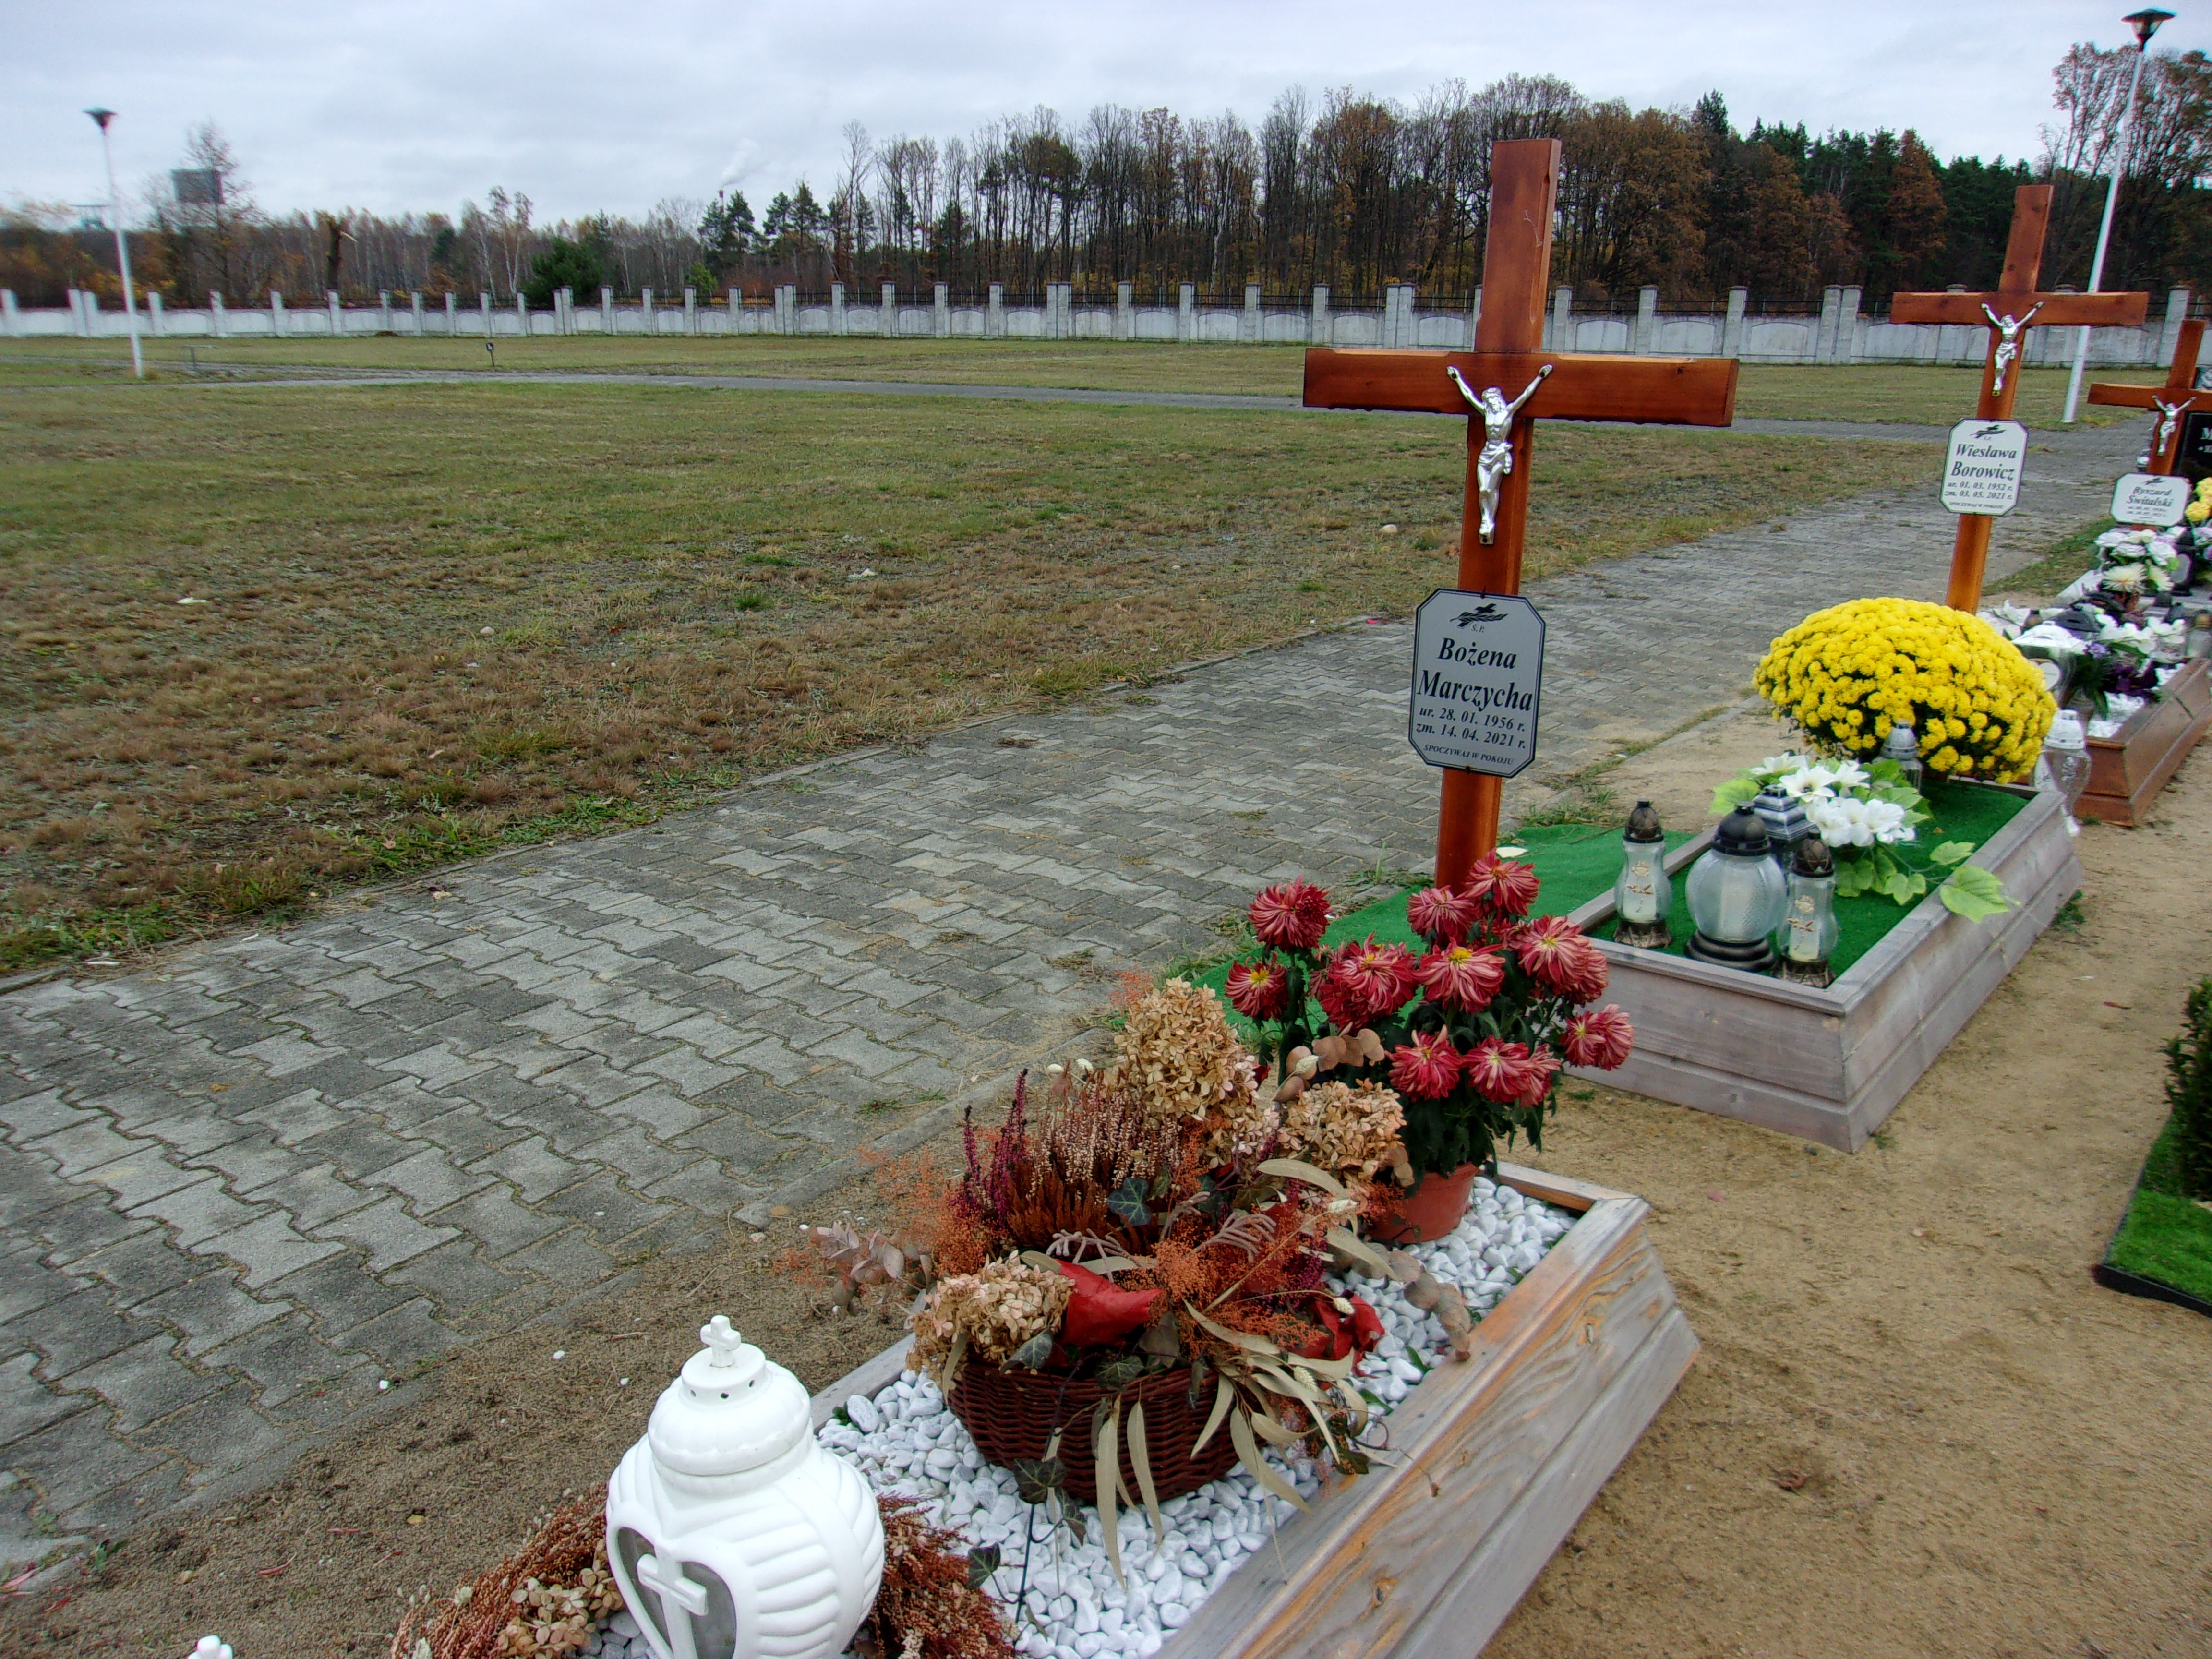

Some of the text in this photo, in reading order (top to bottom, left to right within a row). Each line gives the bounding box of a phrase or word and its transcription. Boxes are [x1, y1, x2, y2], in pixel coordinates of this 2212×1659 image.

[1951, 461, 2015, 481] Borowicz
[1437, 637, 1516, 669] Bożena
[1417, 670, 1533, 712] Marczycha
[1419, 708, 1525, 732] ur. 28. 01. 1956 r.
[1416, 723, 1525, 748] zm. 14. 04. 2021 r.
[1424, 744, 1470, 757] SPOCZYWAJ
[1481, 754, 1514, 765] POKOJU
